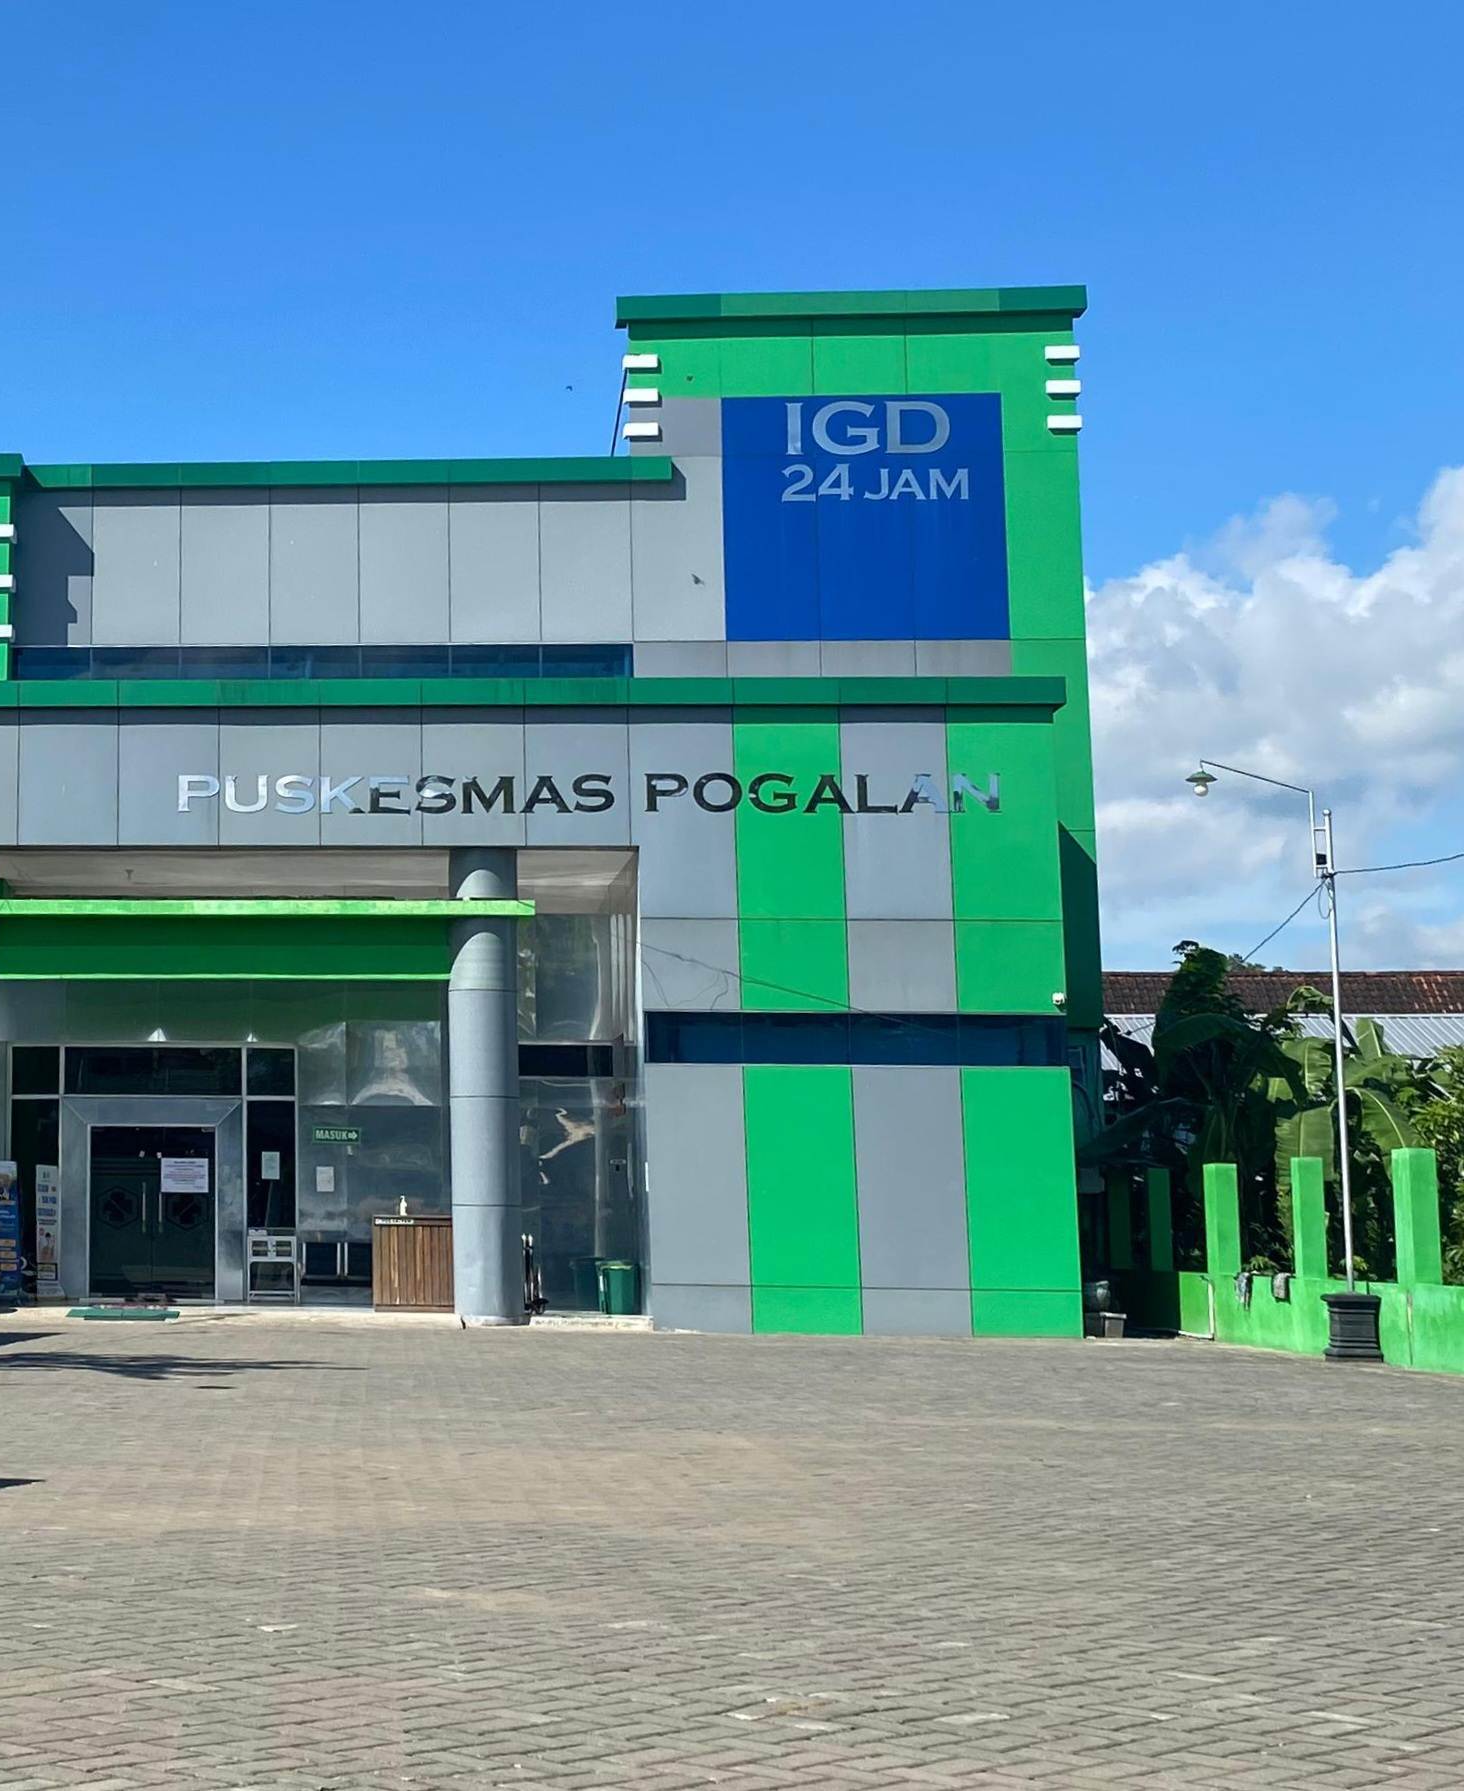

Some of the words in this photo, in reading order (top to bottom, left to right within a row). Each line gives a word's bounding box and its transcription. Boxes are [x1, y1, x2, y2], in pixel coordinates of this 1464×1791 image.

[784, 400, 951, 455] IGD
[781, 463, 854, 502] 24
[863, 467, 970, 501] JAM
[177, 774, 616, 814] PUSKESMAS
[644, 773, 1003, 814] POGALAN
[316, 1129, 348, 1140] MASUK
